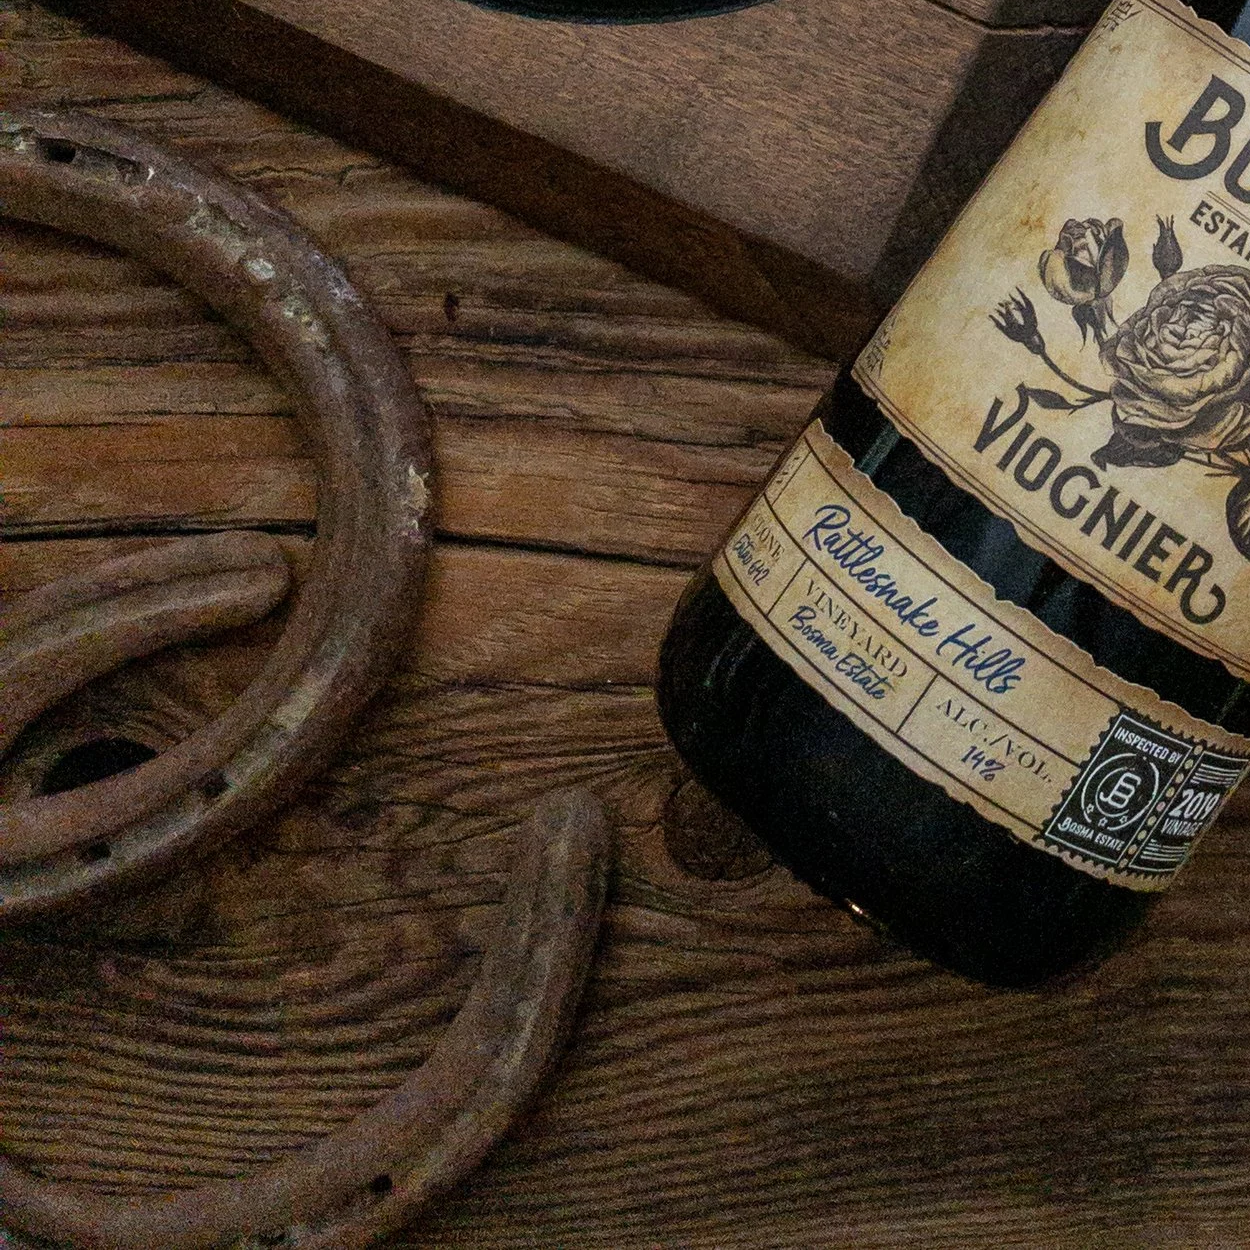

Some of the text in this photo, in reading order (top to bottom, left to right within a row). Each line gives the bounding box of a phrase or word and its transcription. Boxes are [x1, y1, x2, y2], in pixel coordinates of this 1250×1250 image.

[972, 384, 1226, 625] VIOGNIER
[802, 504, 1026, 694] Rattlesnake Hills
[805, 578, 908, 678] VINEYARD
[787, 605, 897, 700] Bosma Estate
[960, 745, 1006, 782] 14%
[1114, 727, 1184, 765] INSPECTED BY
[1058, 817, 1126, 851] BOSMA ESTATE
[1168, 788, 1220, 821] 2019
